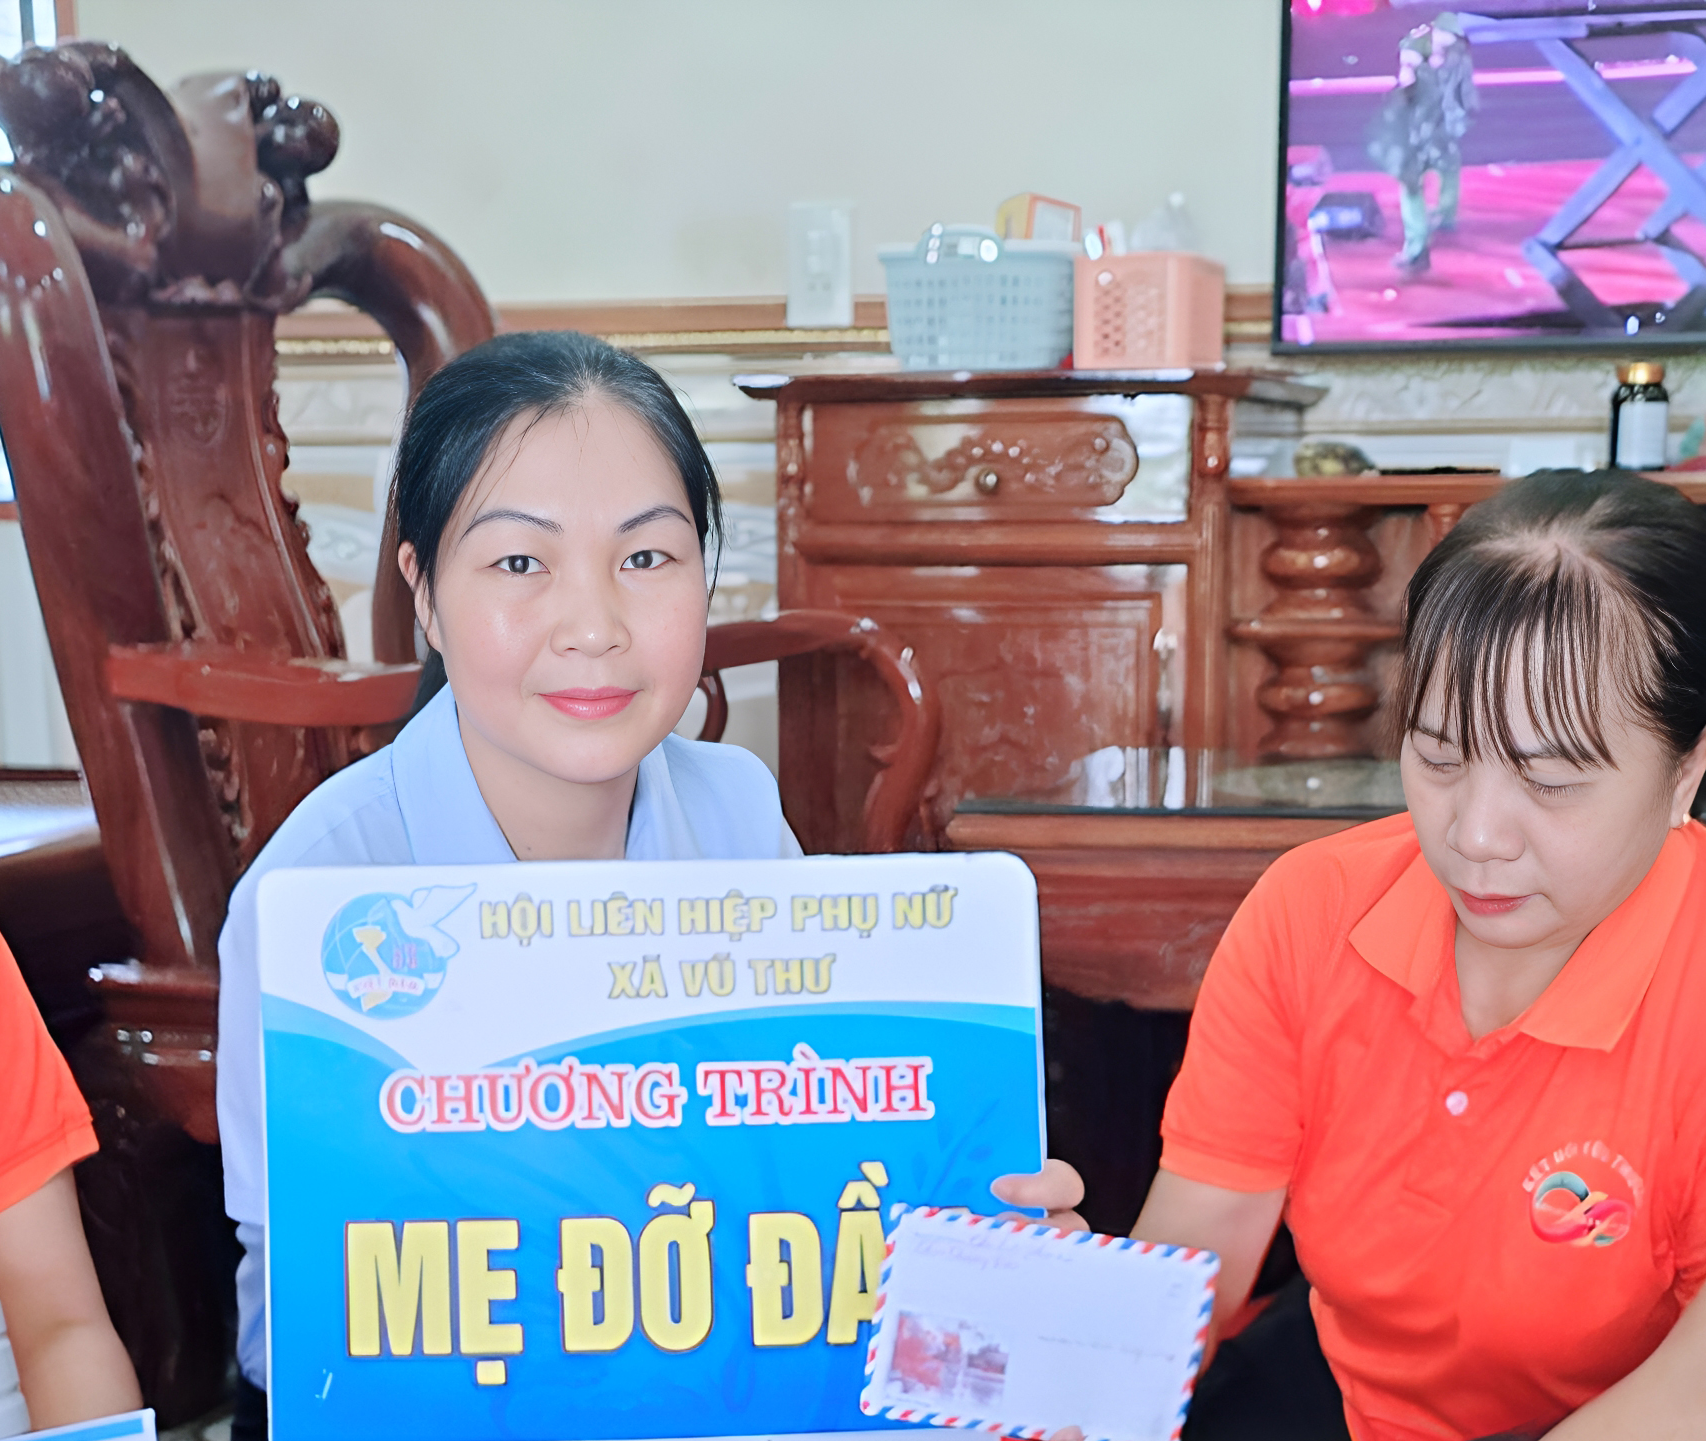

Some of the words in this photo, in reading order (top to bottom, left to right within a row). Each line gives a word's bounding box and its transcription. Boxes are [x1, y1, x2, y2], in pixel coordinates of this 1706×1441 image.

[481, 893, 554, 946] HỘI
[568, 891, 664, 937] LIÊN
[678, 889, 777, 942] HIỆP
[791, 893, 879, 938] PHỤ
[892, 884, 959, 931] NỮ
[608, 953, 668, 999] XÃ
[748, 953, 836, 995] THƯ
[387, 1058, 685, 1130] CHƯƠNG
[698, 1045, 931, 1122] TRÌNH
[345, 1218, 524, 1387] MẸ
[556, 1181, 716, 1354] ĐỠ
[746, 1160, 891, 1347] ĐẦ
